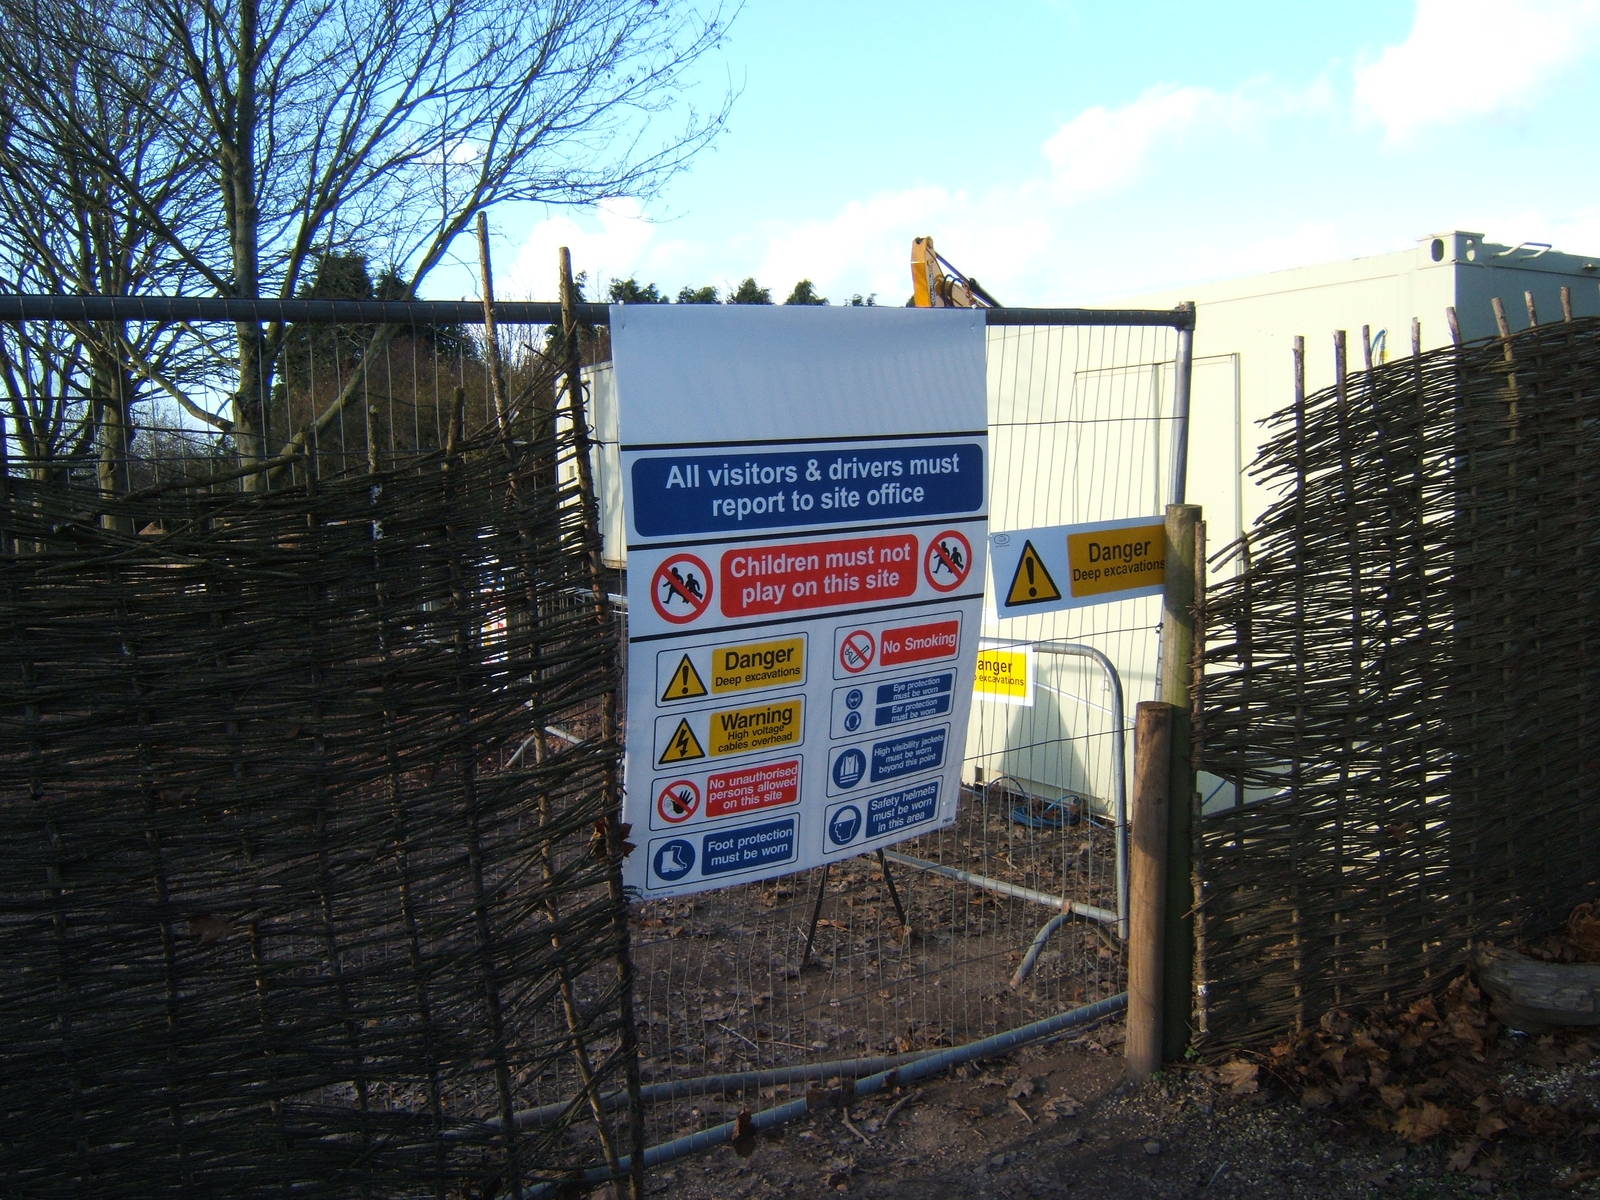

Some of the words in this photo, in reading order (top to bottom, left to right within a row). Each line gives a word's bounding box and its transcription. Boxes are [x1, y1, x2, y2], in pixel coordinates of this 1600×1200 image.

[665, 464, 700, 489] All
[707, 462, 798, 487] visitors
[805, 458, 822, 482] &
[828, 457, 903, 480] drivers
[909, 452, 960, 476] must
[712, 490, 785, 520] report
[791, 488, 814, 511] to
[820, 486, 860, 508] site
[866, 483, 925, 506] office
[730, 554, 819, 578] Children
[825, 546, 875, 568] must
[880, 543, 911, 563] not
[1088, 540, 1152, 563] Danger
[1073, 569, 1101, 582] Deep
[1104, 559, 1167, 577] excavations
[742, 581, 786, 608] play
[792, 580, 817, 597] on
[824, 573, 860, 594] this
[865, 569, 900, 589] site
[883, 640, 901, 655] No
[905, 632, 956, 651] Smoking
[725, 647, 794, 671] Danger
[977, 659, 1012, 676] anger
[715, 675, 742, 687] Deep
[745, 666, 801, 682] excavations
[893, 683, 906, 693] Eye
[907, 677, 941, 691] protection
[979, 674, 1025, 686] excavations
[893, 691, 910, 701] must
[922, 686, 939, 695] worn
[891, 705, 903, 714] Ear
[905, 699, 938, 713] protection
[891, 712, 908, 722] must
[909, 711, 919, 719] be
[920, 708, 936, 716] worn
[720, 707, 793, 731] Warning
[718, 740, 749, 752] cables
[751, 732, 793, 747] overhead
[727, 729, 749, 741] High
[752, 724, 784, 738] voltage
[873, 747, 891, 757] High
[892, 740, 919, 752] visibility
[920, 735, 945, 747] jackets
[885, 752, 903, 763] must
[904, 751, 914, 759] be
[915, 746, 932, 756] worn
[878, 760, 904, 774] beyond
[905, 758, 918, 768] this
[919, 753, 937, 765] point
[709, 778, 725, 790] No
[729, 765, 799, 786] unauthorised
[709, 786, 754, 803] persons
[757, 776, 797, 793] allowed
[723, 800, 737, 810] on
[741, 796, 760, 807] this
[763, 790, 783, 802] site
[871, 796, 900, 811] Safety
[902, 785, 936, 802] helmets
[872, 810, 895, 822] must
[897, 805, 909, 815] be
[911, 798, 932, 811] worn
[877, 822, 886, 833] in
[888, 817, 904, 829] this
[906, 811, 925, 822] area
[707, 838, 734, 853] Foot
[737, 828, 793, 848] protection
[711, 851, 740, 866] must
[743, 849, 758, 861] be
[761, 843, 789, 857] worn
